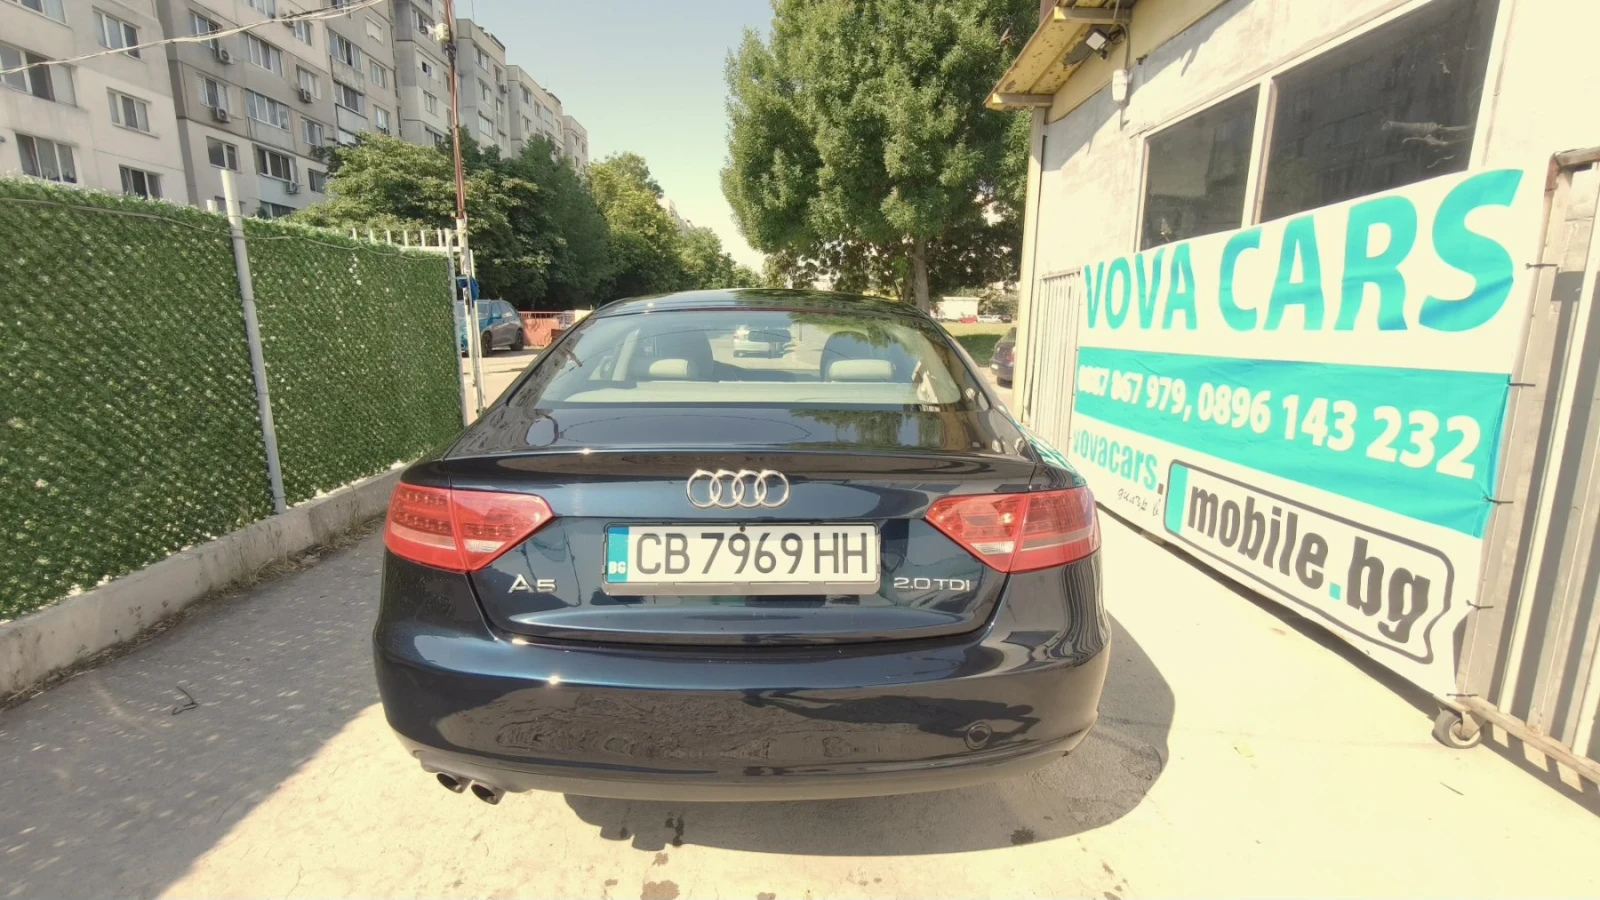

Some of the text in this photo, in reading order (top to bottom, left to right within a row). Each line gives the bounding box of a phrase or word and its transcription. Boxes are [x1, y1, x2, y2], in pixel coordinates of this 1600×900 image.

[1084, 169, 1525, 333] VOVA CARS
[1146, 374, 1193, 423] 979,
[1197, 382, 1272, 434] 0896
[1282, 394, 1358, 452] 143
[1365, 405, 1482, 480] 232
[608, 561, 628, 575] BG
[636, 532, 868, 575] CB 7969 HH
[1187, 485, 1431, 644] mobile.bg
[507, 573, 558, 594] A5
[893, 577, 970, 591] 2.0 TDI
